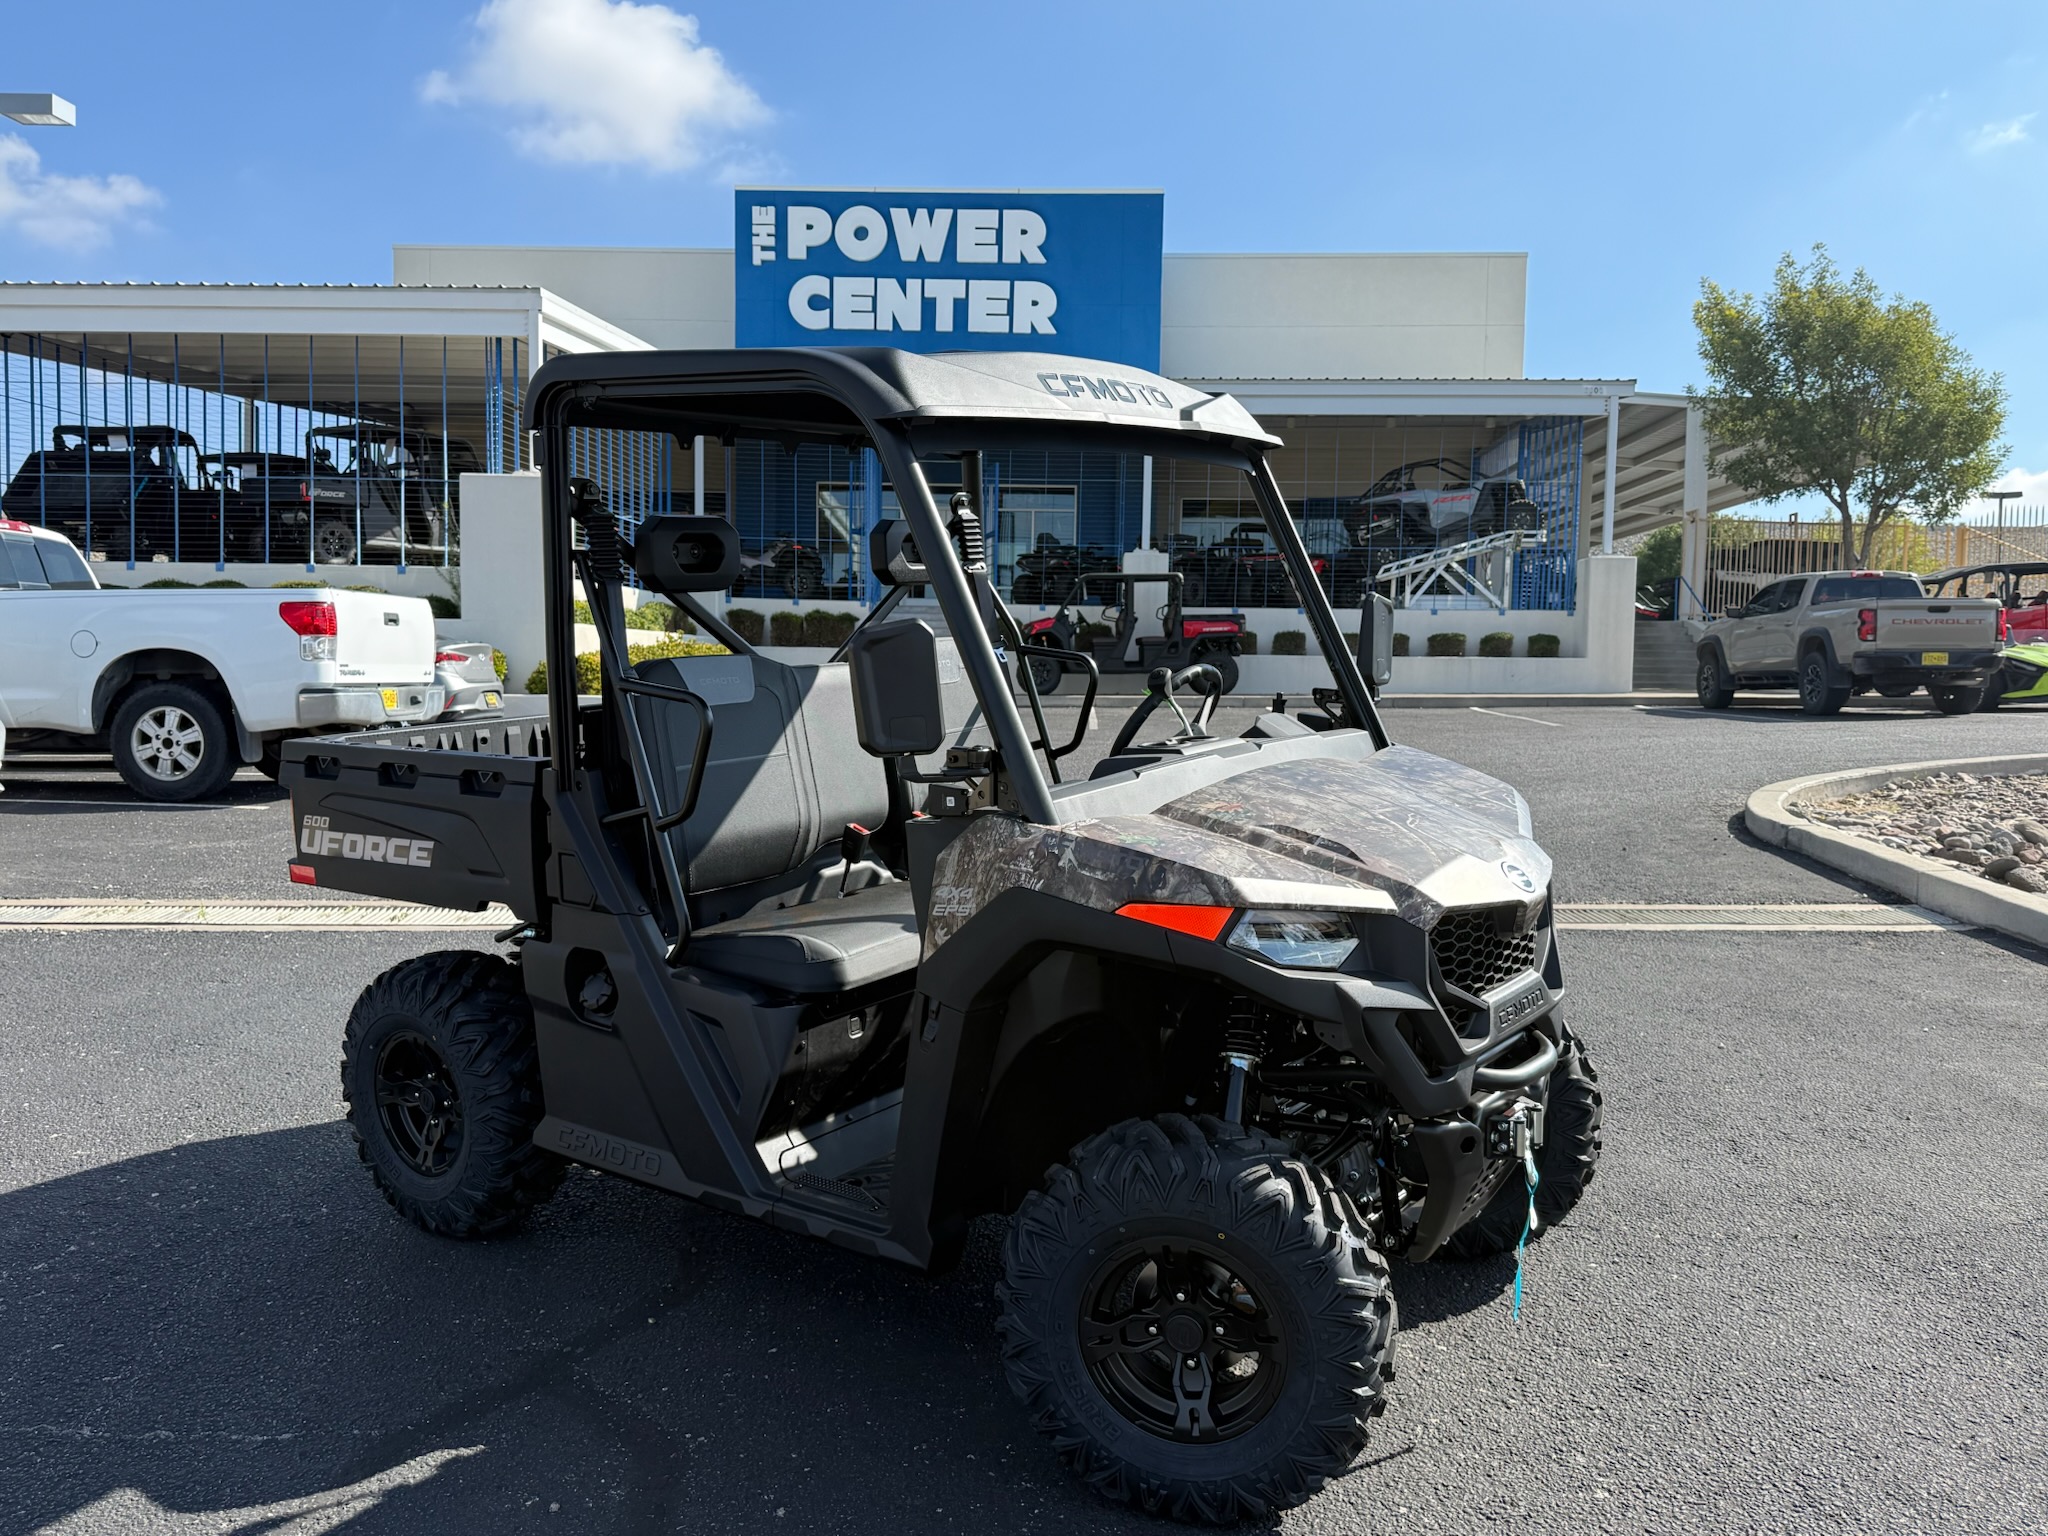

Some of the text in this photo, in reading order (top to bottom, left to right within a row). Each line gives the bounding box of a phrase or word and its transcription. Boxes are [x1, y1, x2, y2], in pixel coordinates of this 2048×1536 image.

[751, 205, 776, 266] THE
[787, 205, 1047, 265] POWER
[788, 274, 1058, 335] CENTER
[1037, 373, 1173, 409] CFMOTO
[303, 814, 330, 828] 600
[300, 828, 435, 868] UFORCE
[932, 904, 971, 917] EPS
[935, 886, 974, 900] 4X4
[1498, 988, 1544, 1028] CFMOTO
[558, 1126, 662, 1177] CFMOTO
[1058, 1358, 1124, 1442] BRUISER
